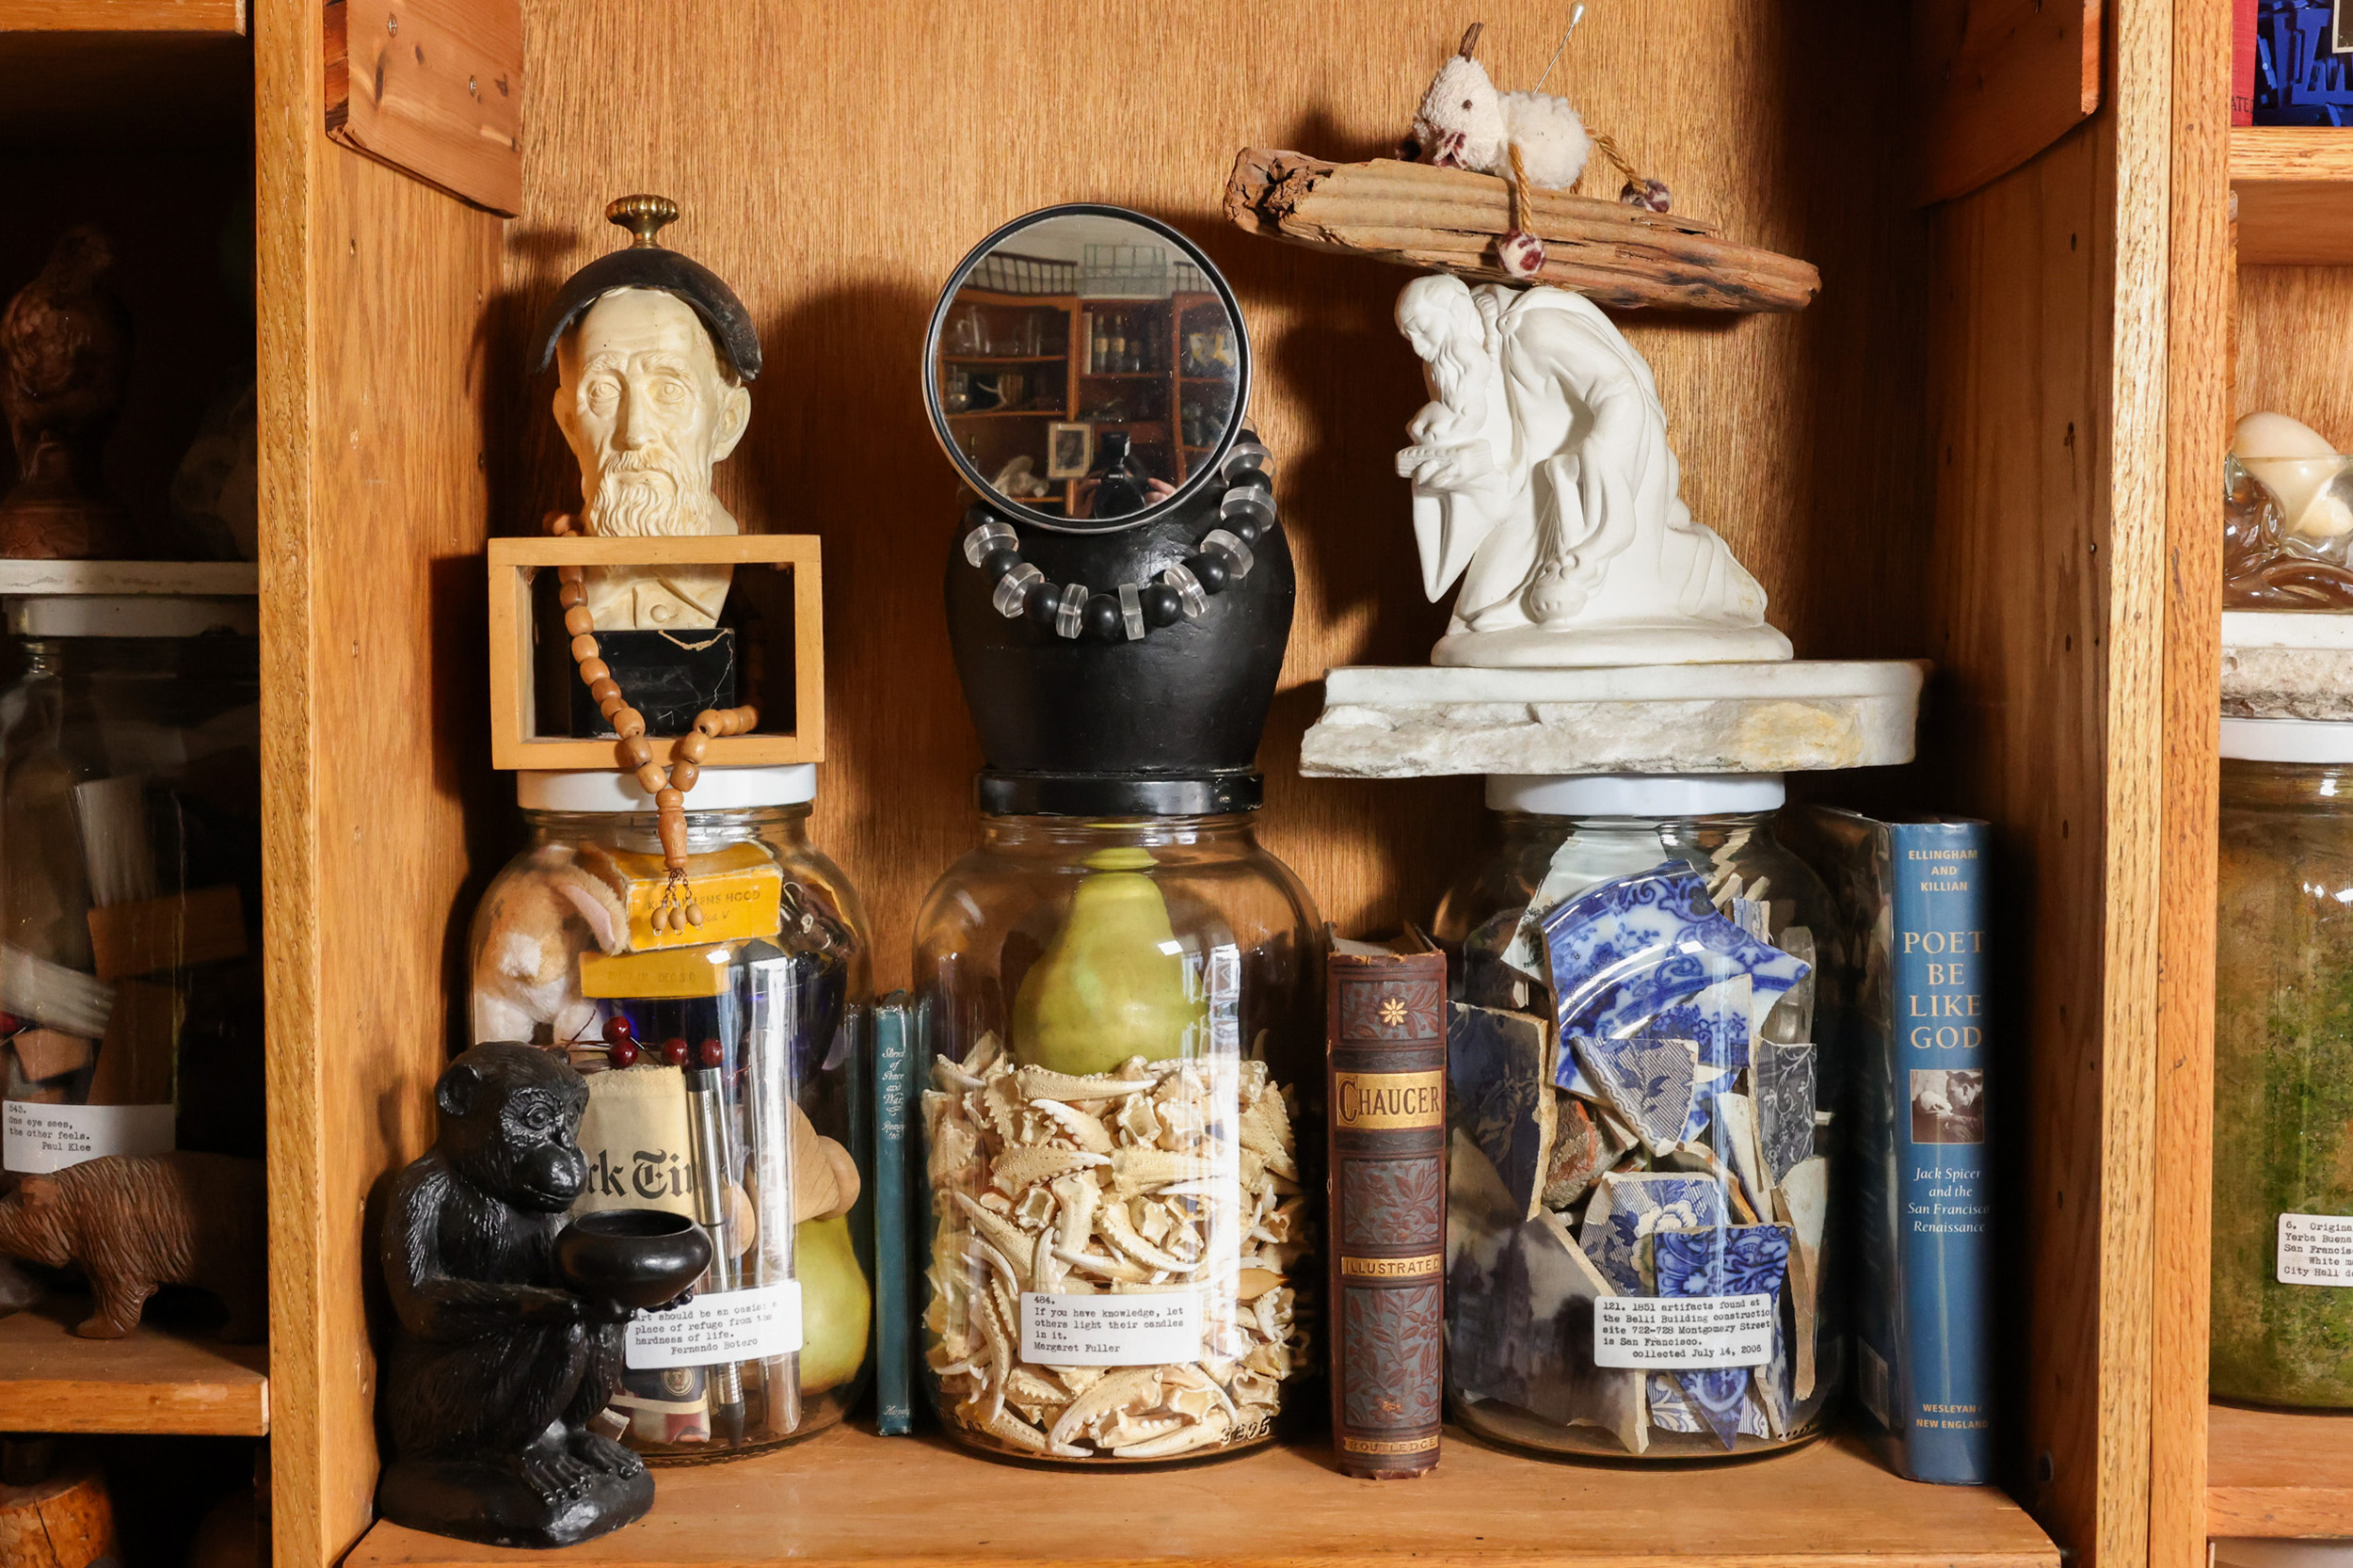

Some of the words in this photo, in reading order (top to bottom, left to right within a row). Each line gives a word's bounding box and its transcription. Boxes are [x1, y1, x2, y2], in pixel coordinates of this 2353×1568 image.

[1909, 850, 1977, 860] ELLINGHAM
[1931, 866, 1958, 875] AND
[1921, 881, 1968, 891] KILLIAN
[726, 890, 760, 904] HOOD
[1902, 931, 1986, 954] POET
[1926, 963, 1965, 985] BE
[1909, 995, 1982, 1016] LIKE
[1911, 1026, 1982, 1048] GOD
[882, 1047, 904, 1058] Stories
[889, 1059, 903, 1071] of
[882, 1070, 904, 1080] Peace
[886, 1081, 902, 1092] and
[8, 1116, 23, 1125] One
[26, 1119, 42, 1128] eye
[47, 1120, 72, 1129] sees,
[9, 1128, 24, 1136] the
[26, 1129, 53, 1138] other
[58, 1131, 90, 1140] feels.
[42, 1142, 63, 1151] Paul
[68, 1143, 91, 1151] Klee
[1913, 1167, 1942, 1181] Jack
[1945, 1167, 1982, 1183] Spicer
[1929, 1185, 1951, 1197] and
[1954, 1185, 1973, 1197] the
[1908, 1202, 1930, 1214] San
[1933, 1203, 1990, 1215] Francisco
[1913, 1220, 1985, 1233] Renaissance
[2285, 1221, 2297, 1229] 6.
[2310, 1223, 2353, 1233] Origina
[2285, 1232, 2316, 1242] Yerba
[2322, 1235, 2352, 1243] Buena
[2283, 1243, 2303, 1253] San
[2310, 1245, 2353, 1255] Francis
[1346, 1257, 1439, 1274] ILLUSTRATED
[2309, 1256, 2340, 1265] White
[2283, 1266, 2310, 1277] City
[2314, 1268, 2339, 1276] Hall
[1033, 1295, 1055, 1304] 484.
[1603, 1302, 1626, 1311] 121.
[1632, 1303, 1657, 1311] 1851
[1661, 1302, 1714, 1312] artifacts
[1720, 1299, 1746, 1309] found
[1750, 1298, 1760, 1306] at
[659, 1311, 694, 1321] should
[699, 1309, 712, 1318] be
[717, 1308, 729, 1317] an
[1034, 1307, 1047, 1317] If
[1050, 1309, 1067, 1318] you
[1073, 1308, 1096, 1317] have
[1102, 1307, 1160, 1319] knowledge,
[1166, 1307, 1184, 1316] let
[1603, 1315, 1621, 1323] the
[1625, 1315, 1656, 1323] Belli
[1661, 1313, 1708, 1324] Building
[1713, 1309, 1771, 1321] constructio
[635, 1323, 664, 1335] place
[670, 1322, 683, 1332] of
[689, 1320, 724, 1331] refuge
[729, 1317, 752, 1326] from
[1034, 1320, 1068, 1329] others
[1074, 1320, 1102, 1331] light
[1109, 1320, 1138, 1329] their
[1144, 1319, 1184, 1328] candles
[1602, 1325, 1626, 1335] site
[1632, 1325, 1674, 1335] 722-728
[1678, 1323, 1736, 1336] Montgomery
[1739, 1320, 1770, 1331] Street
[635, 1336, 682, 1346] hardness
[688, 1334, 700, 1343] of
[706, 1331, 734, 1341] life.
[1035, 1330, 1047, 1338] in
[1052, 1331, 1067, 1340] it.
[671, 1344, 718, 1355] Fernando
[724, 1337, 758, 1350] Botero
[1033, 1342, 1080, 1352] Margaret
[1085, 1343, 1121, 1352] Fuller
[1604, 1337, 1615, 1346] is
[1620, 1337, 1639, 1346] San
[1644, 1337, 1703, 1346] Francisco.
[1633, 1349, 1686, 1358] collected
[1691, 1348, 1715, 1358] July
[1720, 1347, 1736, 1356] 14,
[1922, 1403, 1977, 1413] WESLEYAN
[1916, 1418, 1939, 1429] NEW
[1942, 1419, 1989, 1429] ENGLAND
